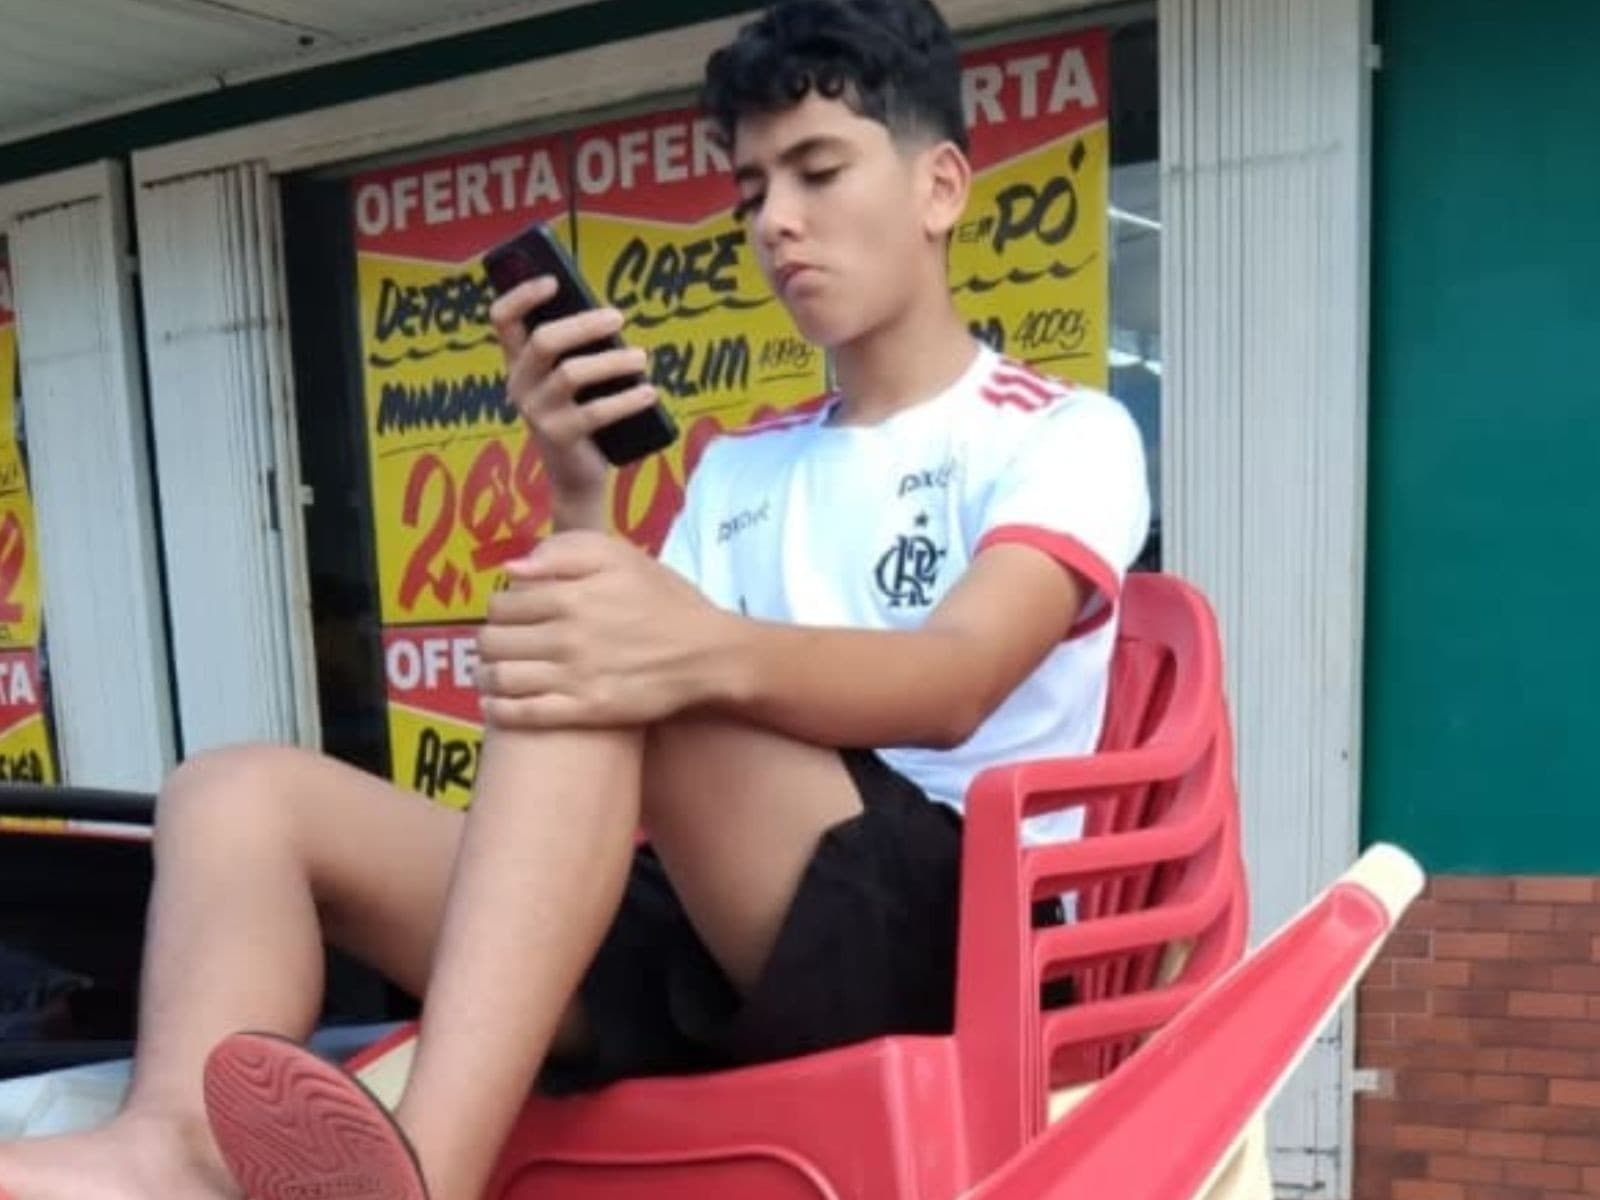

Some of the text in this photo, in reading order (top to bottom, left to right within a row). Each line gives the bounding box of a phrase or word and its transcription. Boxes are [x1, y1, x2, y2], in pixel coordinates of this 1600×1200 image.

[961, 48, 1099, 130] RTA
[355, 149, 563, 236] OFERTA
[576, 116, 734, 195] OFER
[650, 334, 750, 397] RLIM
[385, 637, 481, 691] OFE
